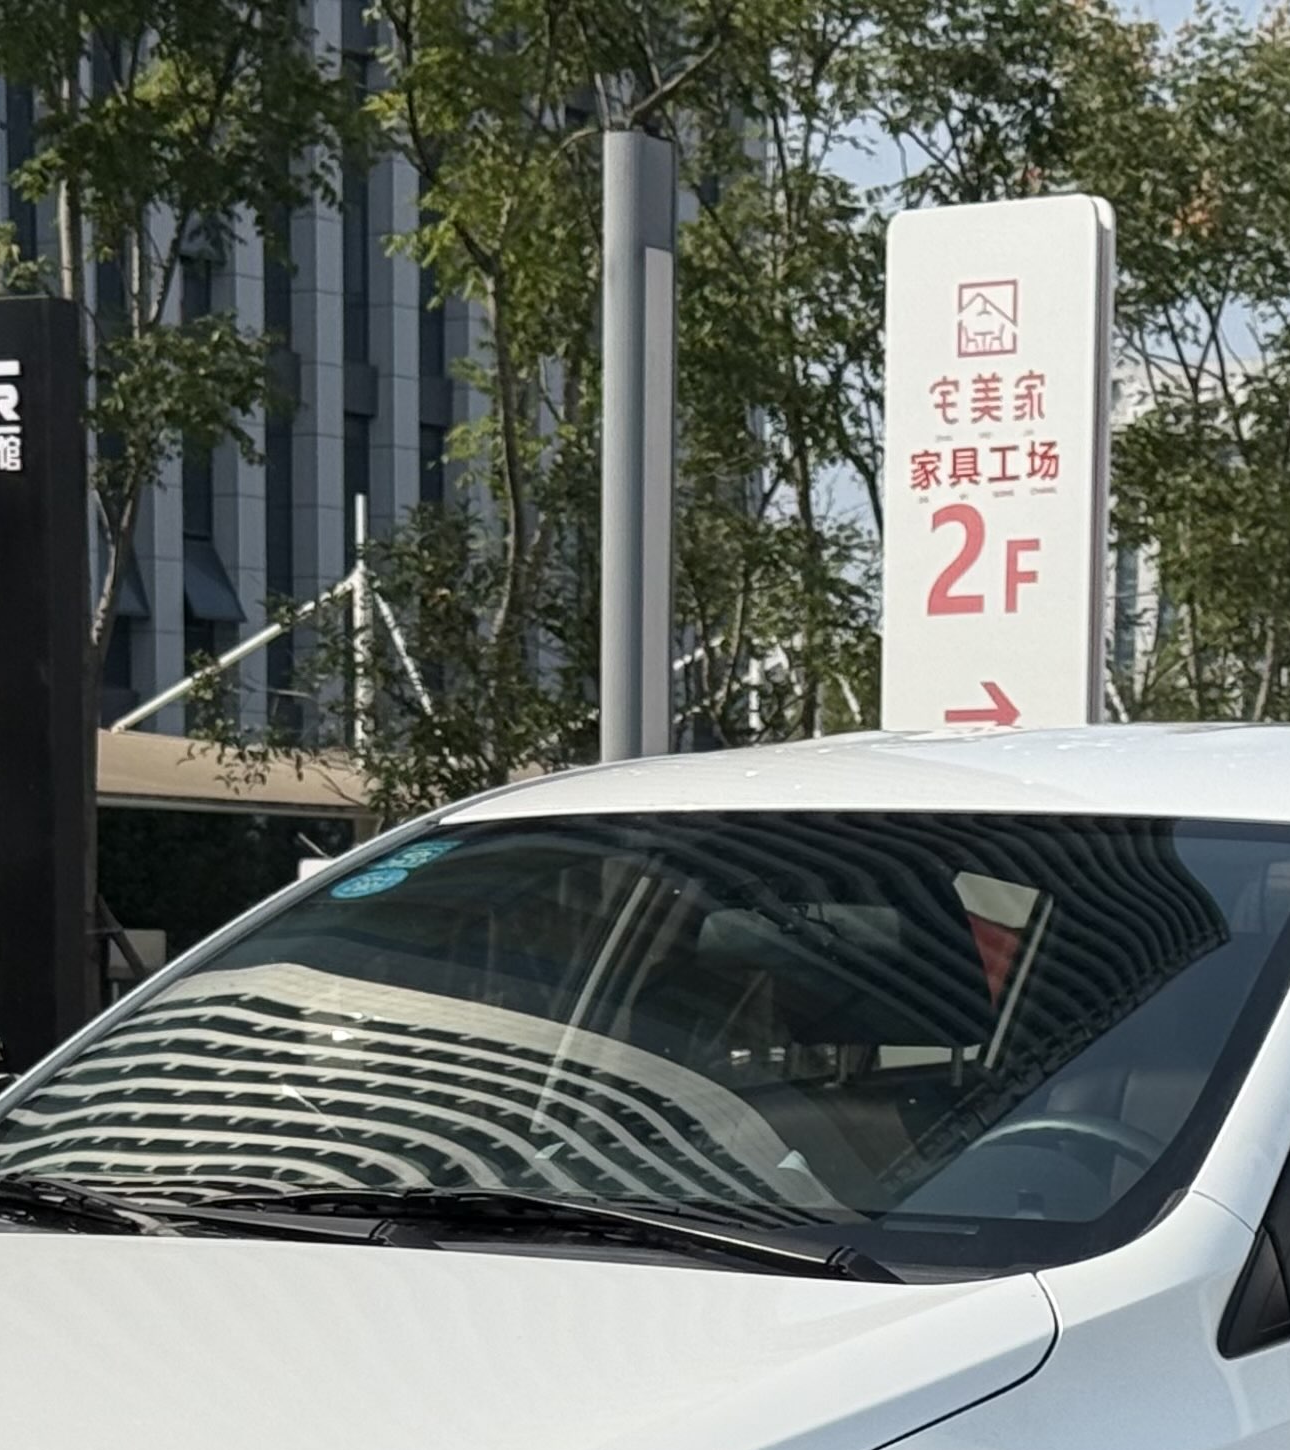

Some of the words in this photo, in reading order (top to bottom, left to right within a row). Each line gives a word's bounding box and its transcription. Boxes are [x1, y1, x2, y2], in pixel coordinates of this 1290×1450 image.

[929, 369, 1046, 425] 宅美家
[910, 440, 1060, 491] 家具工场
[926, 503, 1041, 617] 2F
